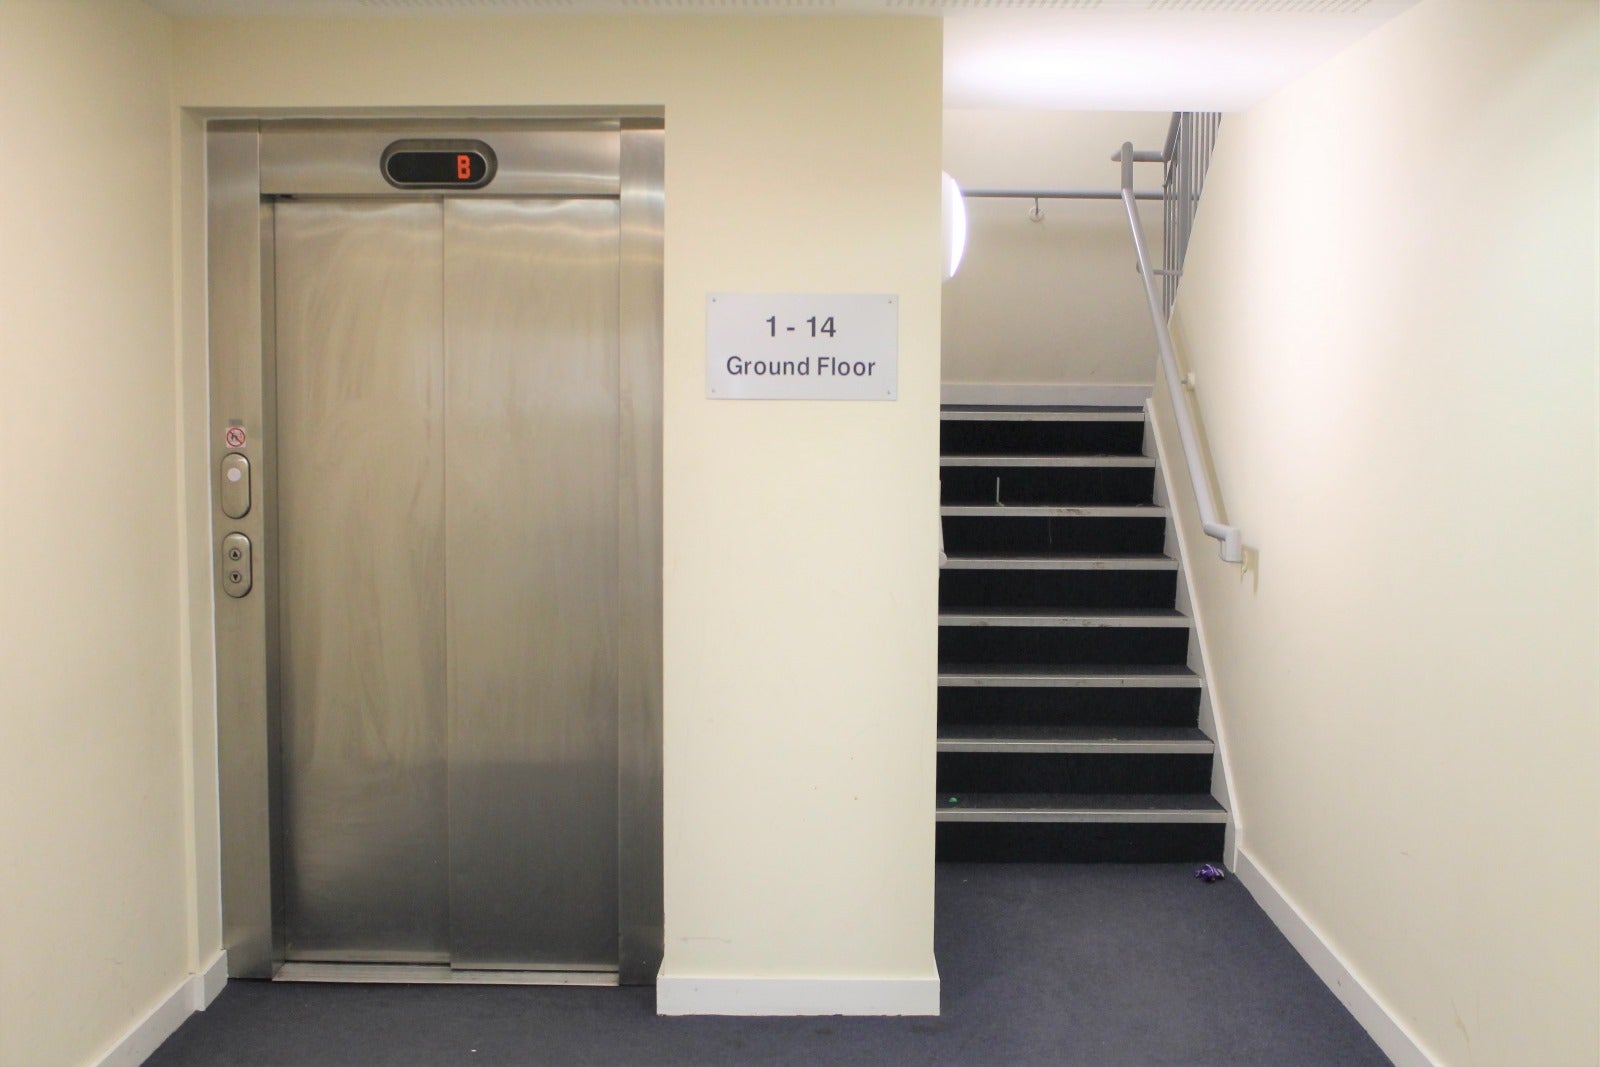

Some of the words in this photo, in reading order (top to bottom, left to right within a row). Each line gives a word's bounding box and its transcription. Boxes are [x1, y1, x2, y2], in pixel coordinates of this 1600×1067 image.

[457, 154, 471, 179] B
[766, 315, 777, 338] 1
[806, 316, 837, 338] 14
[726, 355, 811, 377] Ground
[816, 356, 877, 377] Floor
